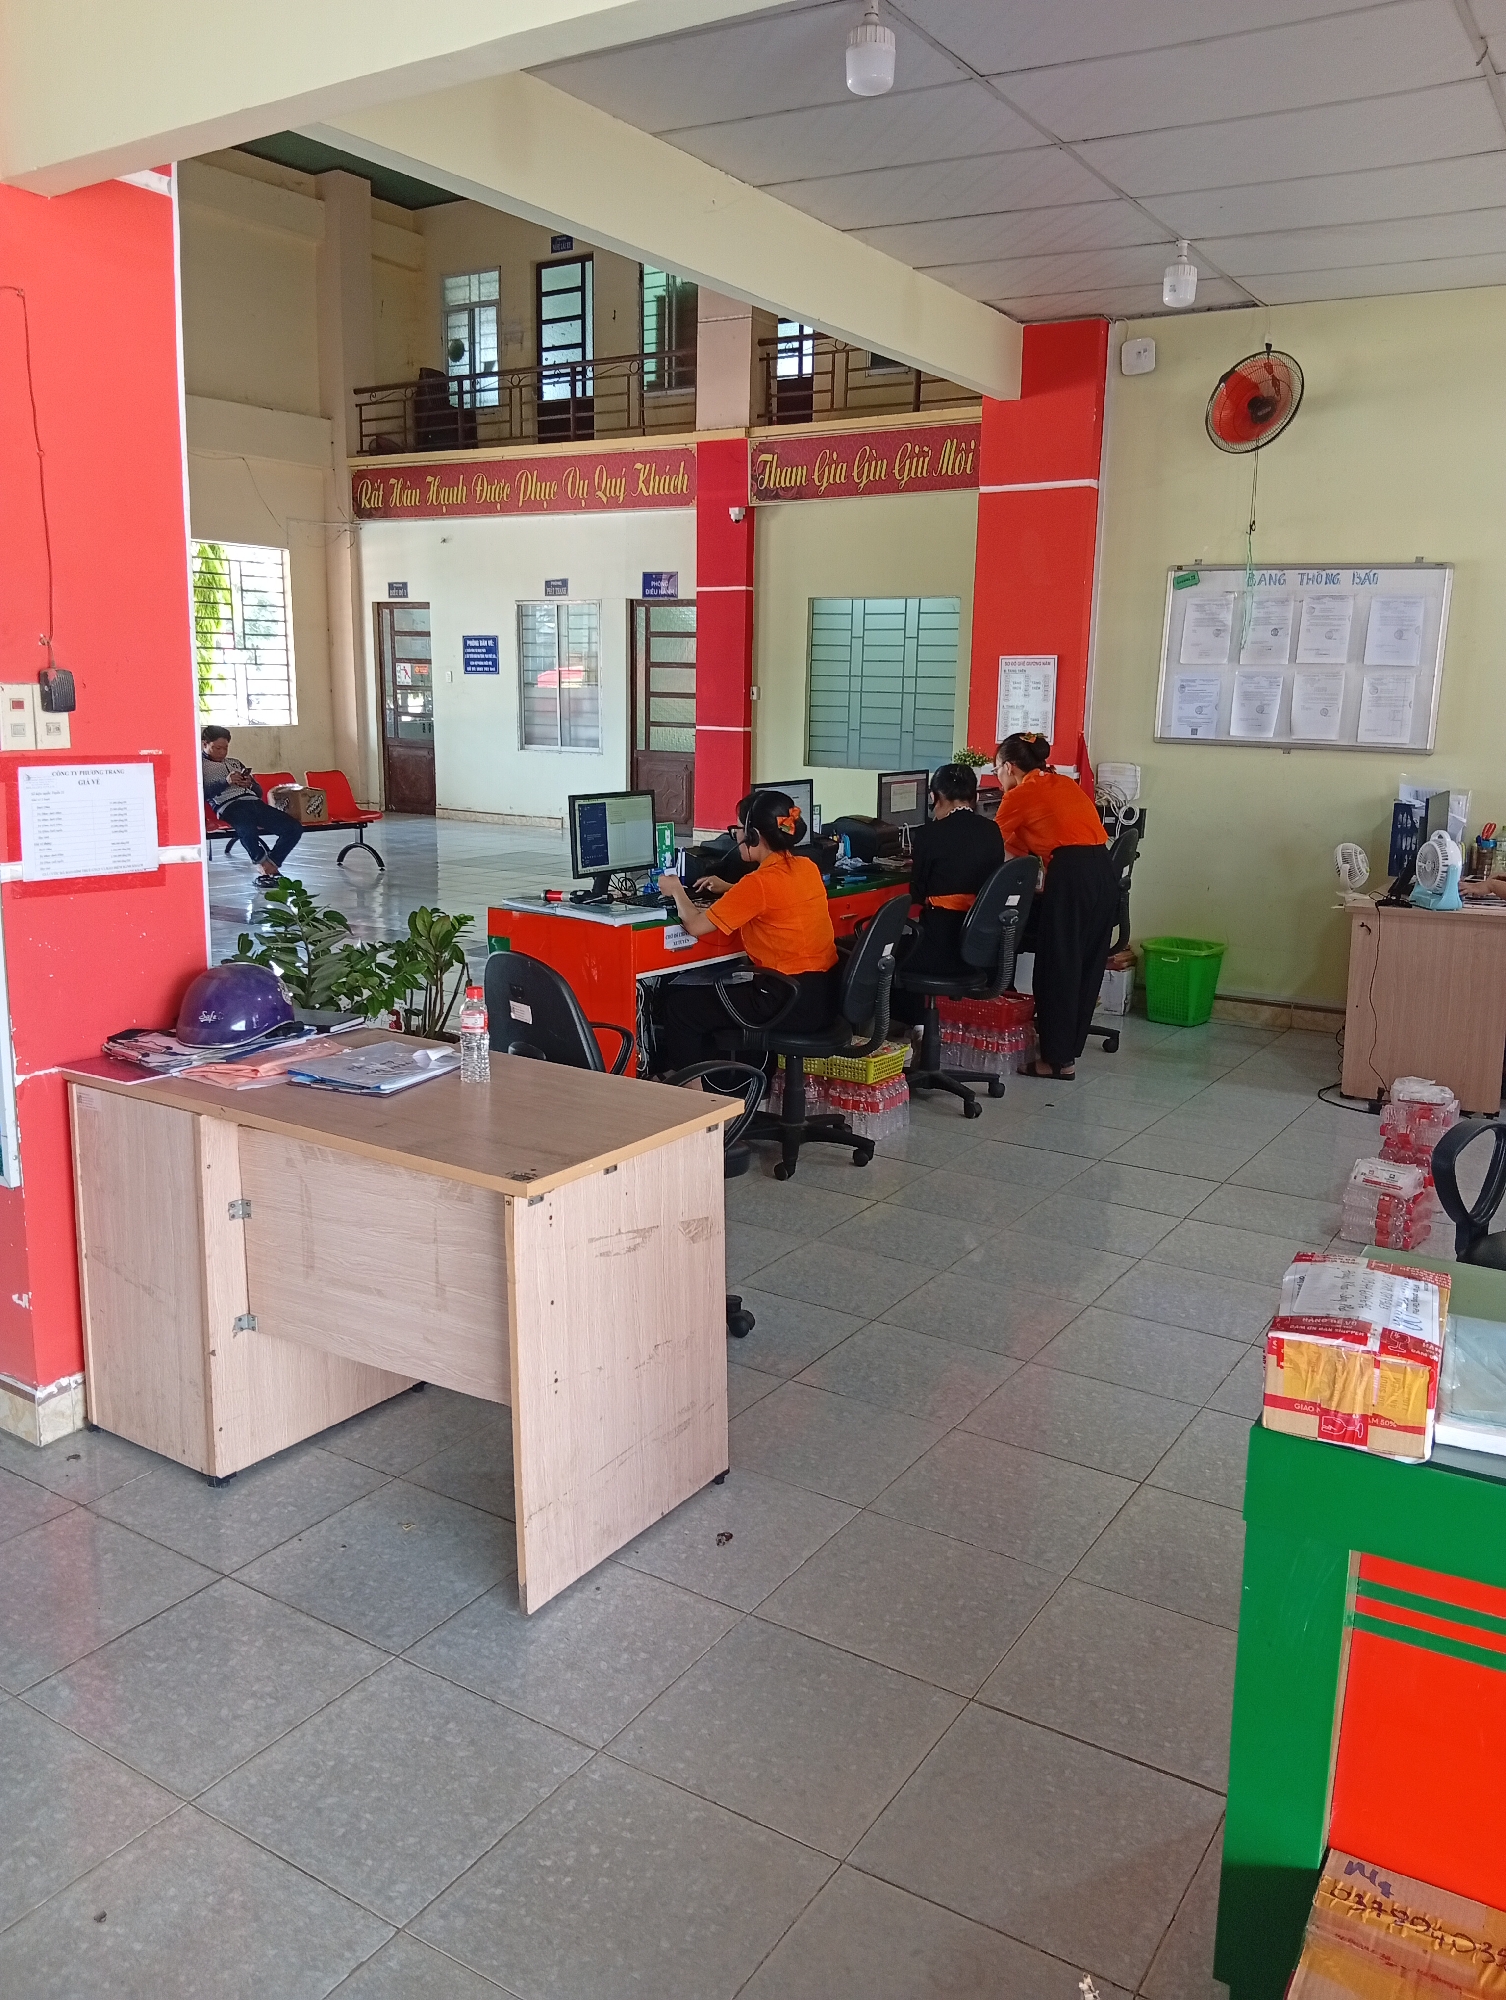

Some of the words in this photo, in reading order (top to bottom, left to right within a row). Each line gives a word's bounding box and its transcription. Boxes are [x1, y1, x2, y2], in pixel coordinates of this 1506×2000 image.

[358, 479, 384, 508] Rất
[389, 478, 420, 507] Hân
[426, 474, 468, 513] Hạnh
[472, 473, 511, 511] Được
[515, 469, 558, 509] Phục
[562, 466, 589, 507] Vụ
[594, 464, 627, 505] Quý
[630, 460, 690, 497] Khách
[756, 453, 808, 490] Tham
[812, 449, 848, 495] Gia
[852, 445, 888, 492] Gìn
[892, 442, 932, 489] Giữ
[932, 438, 976, 477] Môi
[1293, 1403, 1314, 1413] GIAO
